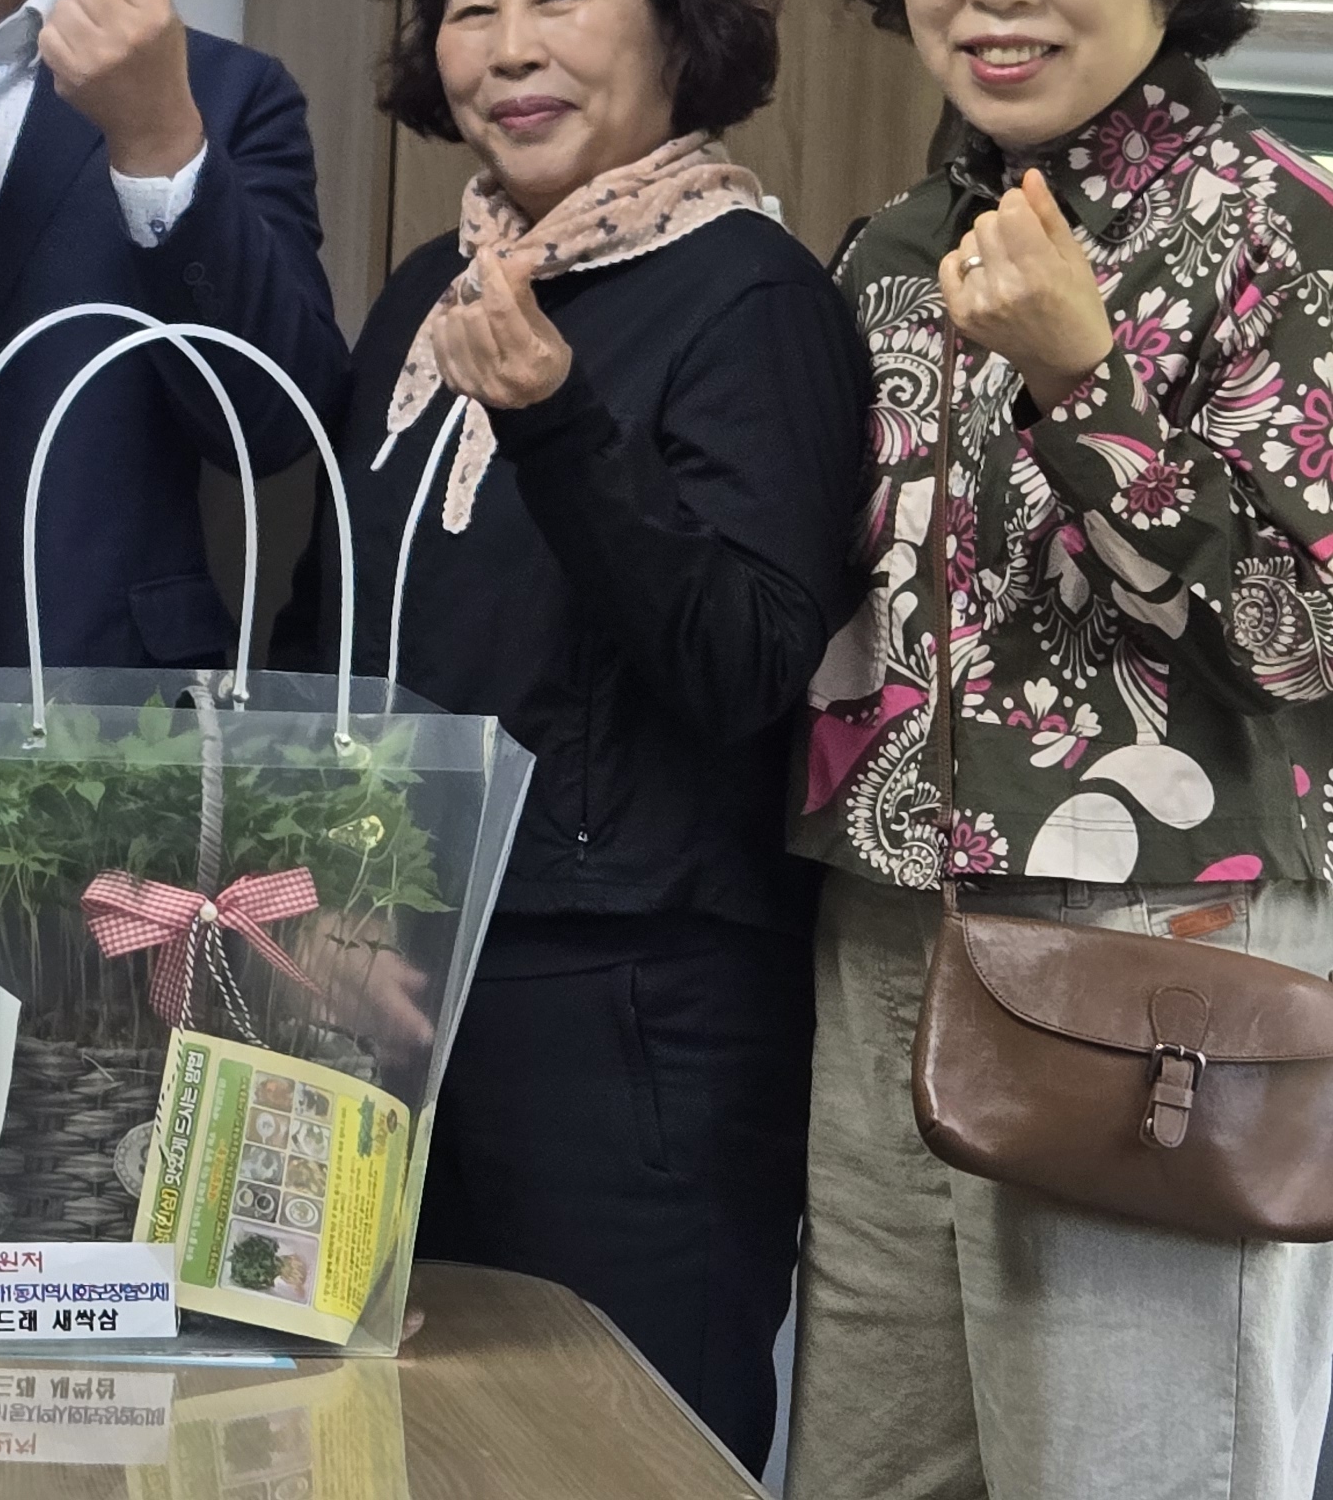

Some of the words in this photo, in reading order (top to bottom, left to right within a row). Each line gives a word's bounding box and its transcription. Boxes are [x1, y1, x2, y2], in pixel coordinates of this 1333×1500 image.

[184, 1050, 205, 1084] 방법
[174, 1087, 200, 1136] 드시는
[165, 1135, 189, 1187] 맛있게
[52, 1308, 119, 1332] 새싹삼
